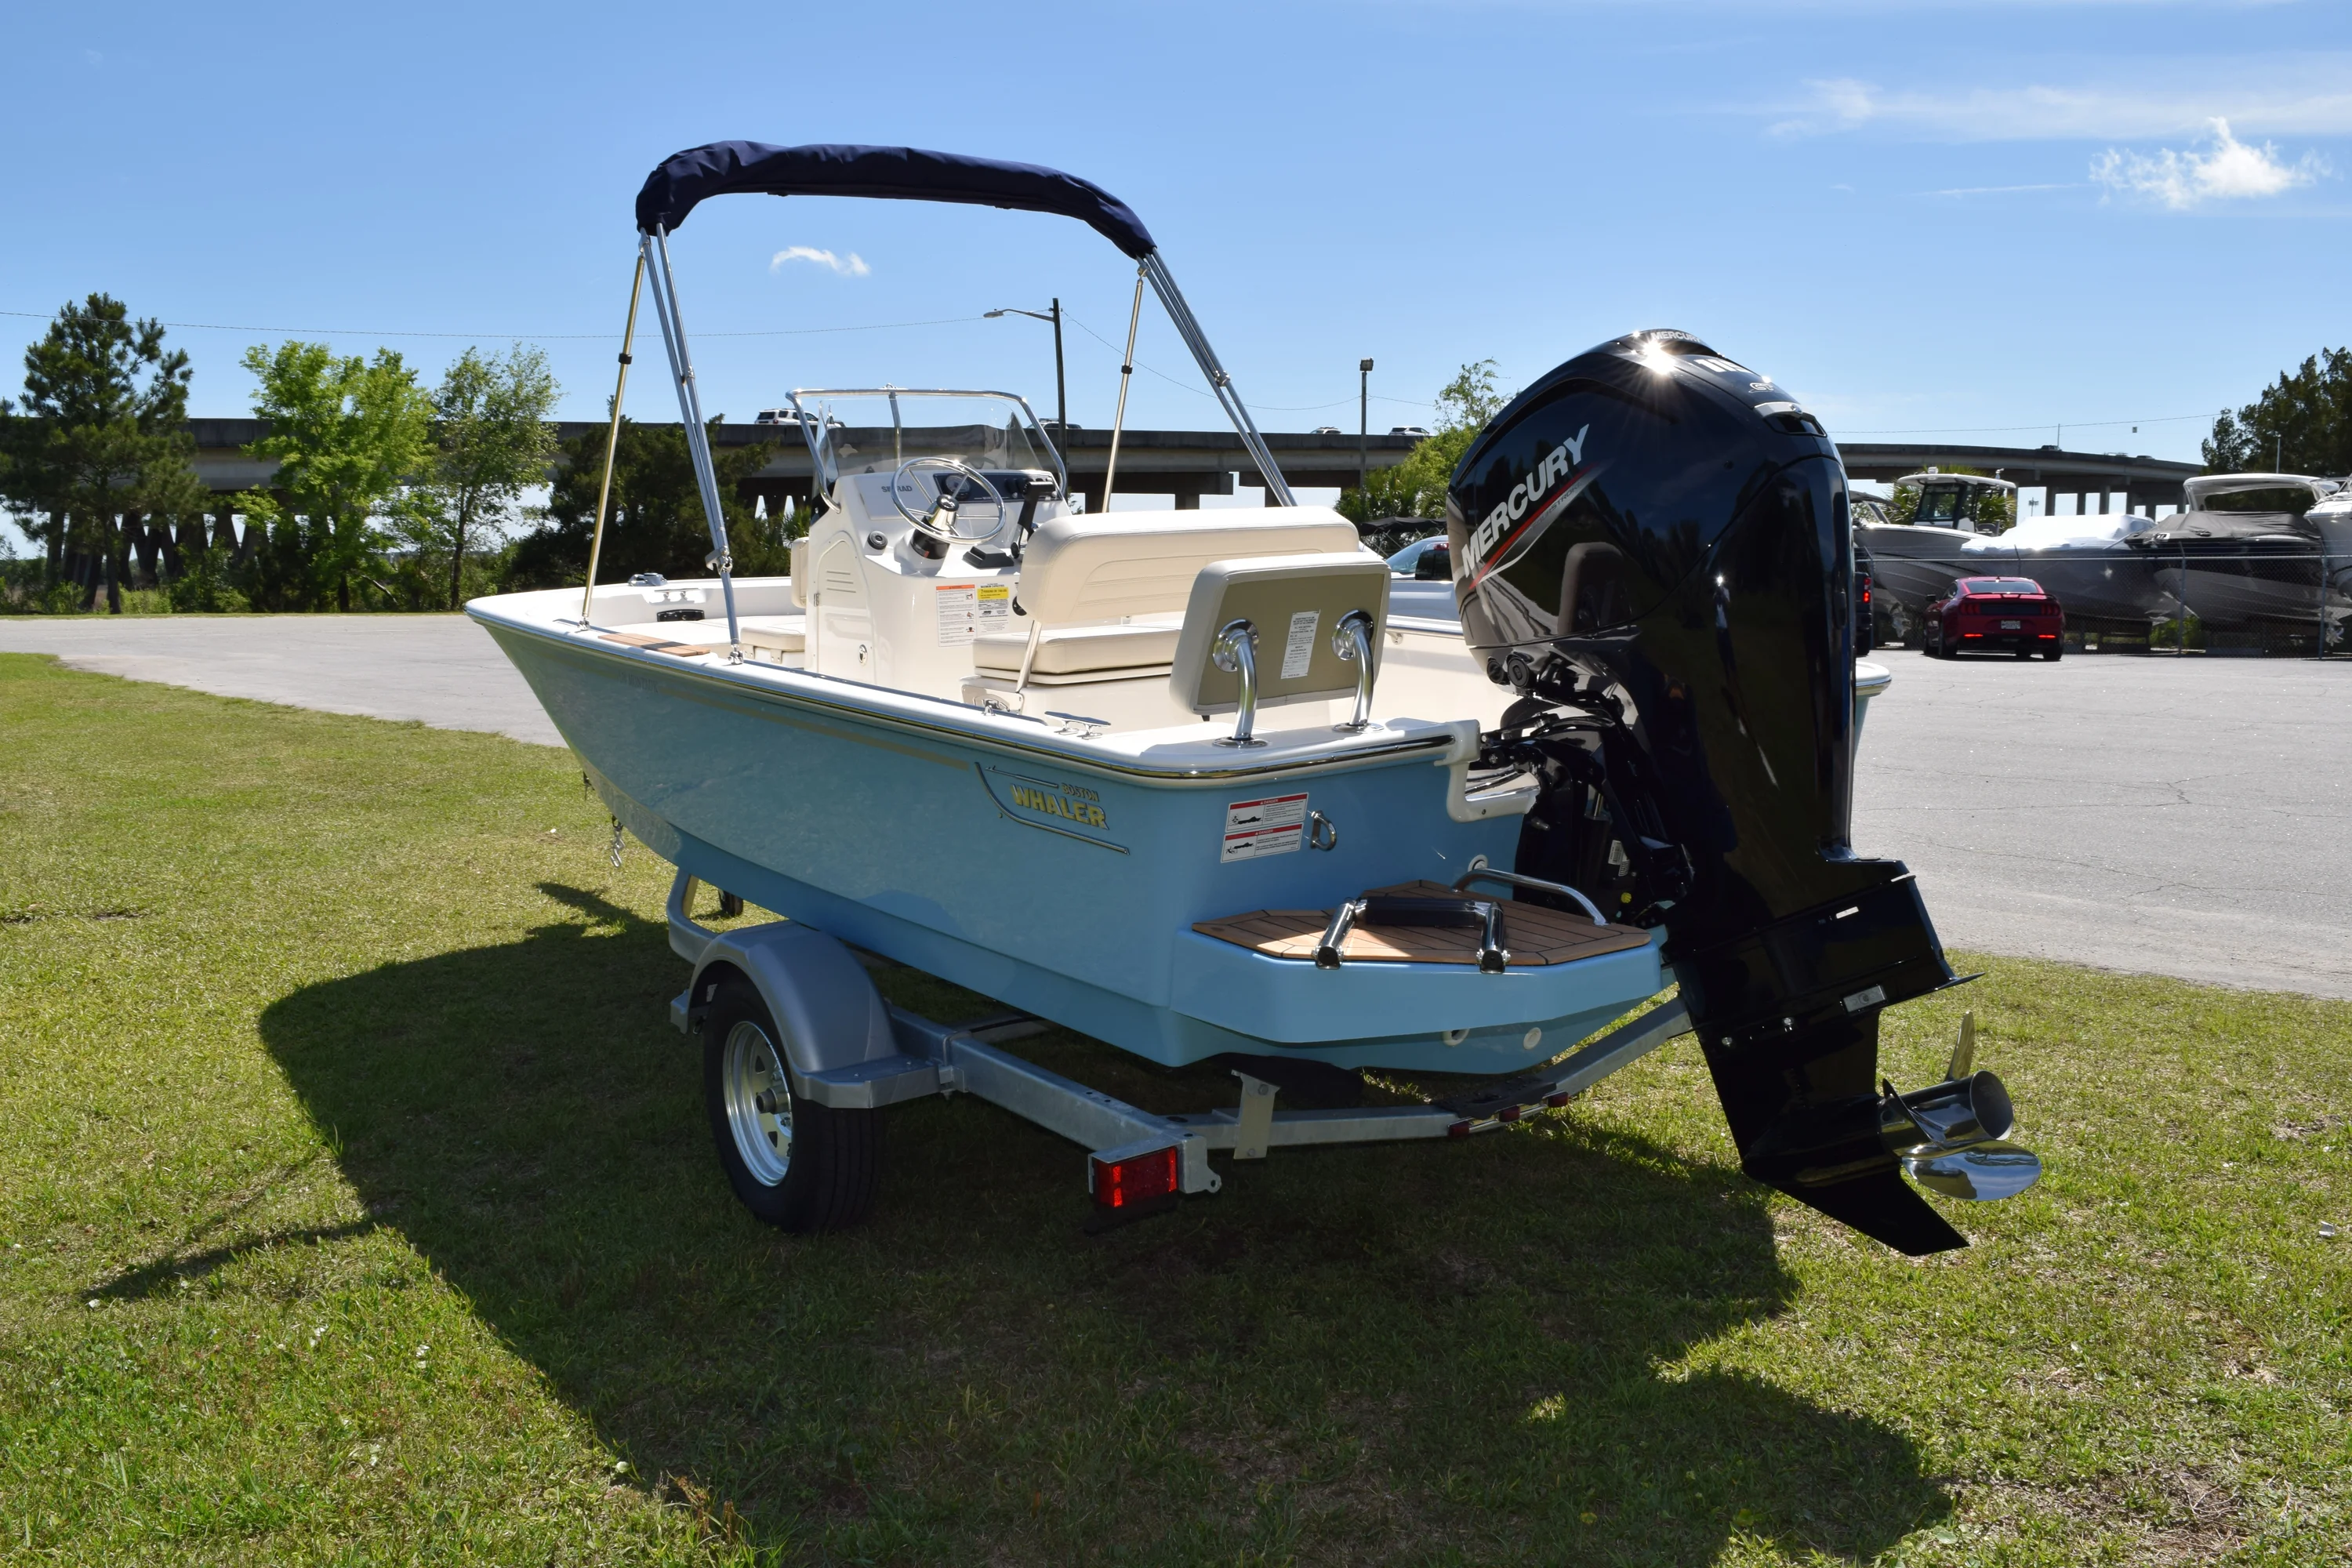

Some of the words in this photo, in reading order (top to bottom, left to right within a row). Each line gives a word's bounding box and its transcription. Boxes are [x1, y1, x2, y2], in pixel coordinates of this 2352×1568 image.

[1650, 331, 1700, 343] MERCURY
[1461, 423, 1589, 578] MERCURY
[1010, 783, 1109, 830] WHALER
[1062, 782, 1099, 802] BOSTON
